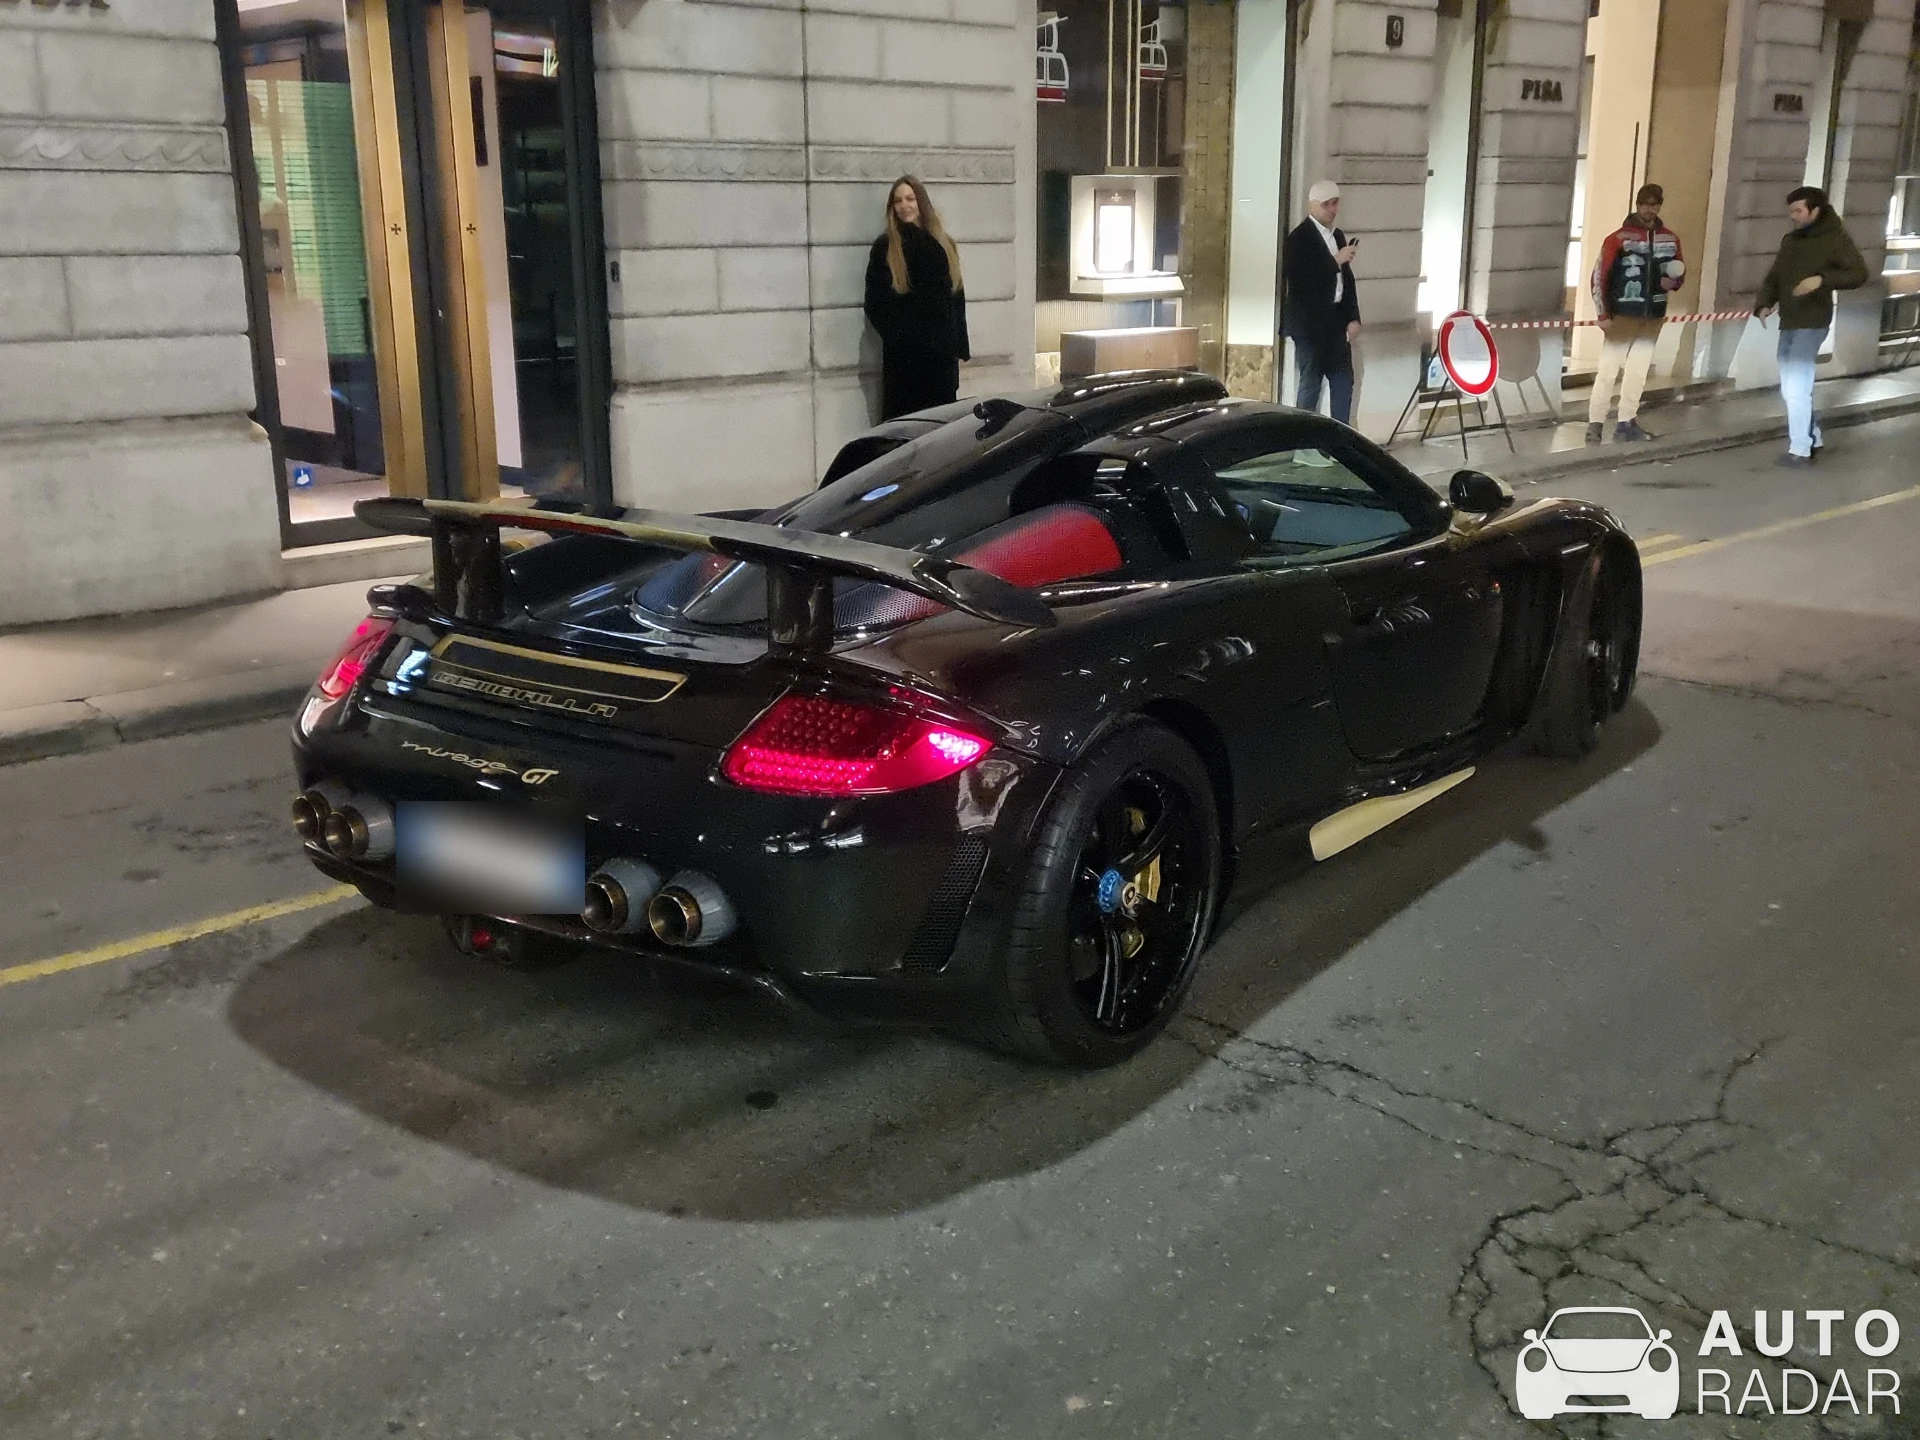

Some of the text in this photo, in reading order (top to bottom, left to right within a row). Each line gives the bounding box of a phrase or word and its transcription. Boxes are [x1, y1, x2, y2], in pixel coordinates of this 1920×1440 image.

[1392, 20, 1401, 40] 9
[1521, 79, 1563, 102] PISA
[432, 671, 618, 718] GEMBALLA
[401, 740, 560, 785] mirage GT
